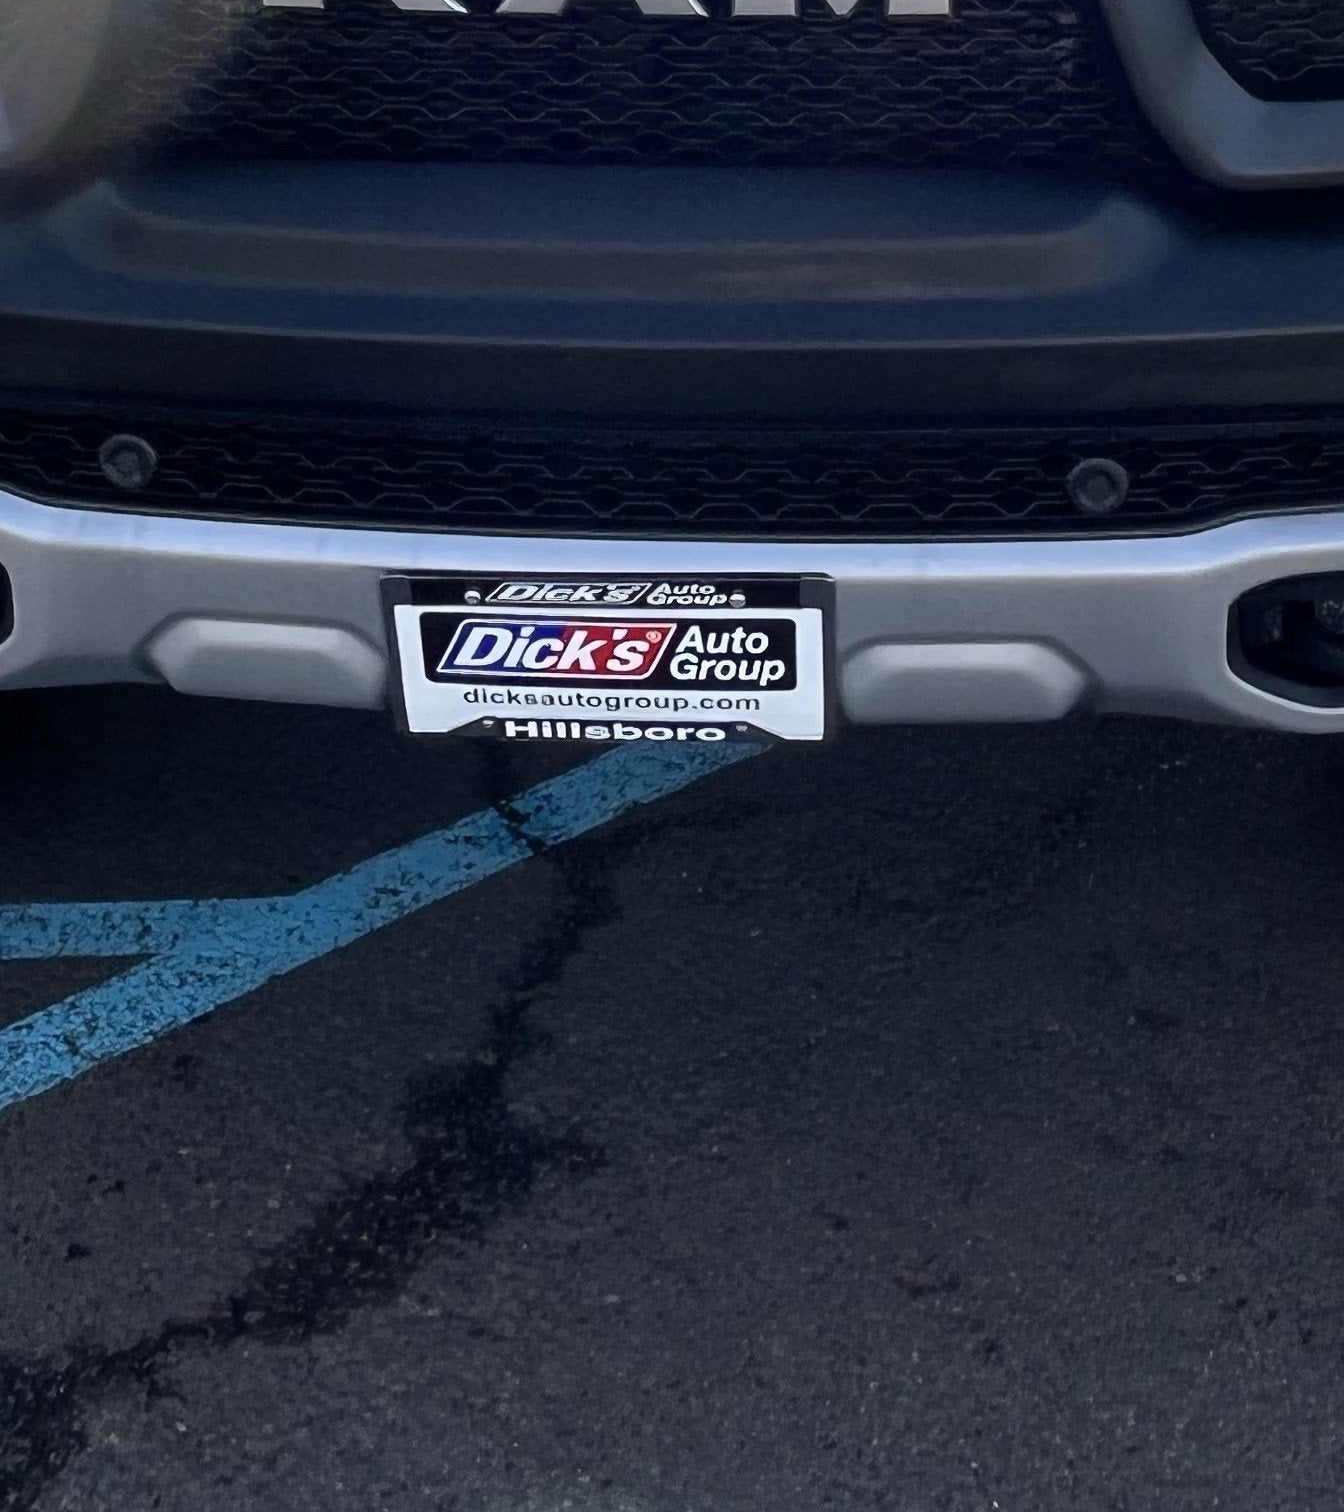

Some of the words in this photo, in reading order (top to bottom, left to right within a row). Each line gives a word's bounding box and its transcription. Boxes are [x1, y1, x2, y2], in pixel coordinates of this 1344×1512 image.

[647, 592, 728, 606] Group
[656, 583, 716, 595] Auto
[454, 626, 649, 673] Dick's
[675, 625, 769, 654] Auto
[669, 652, 785, 686] Group
[463, 688, 760, 711] dicksautogroup.com
[505, 720, 726, 741] Hillsboro
